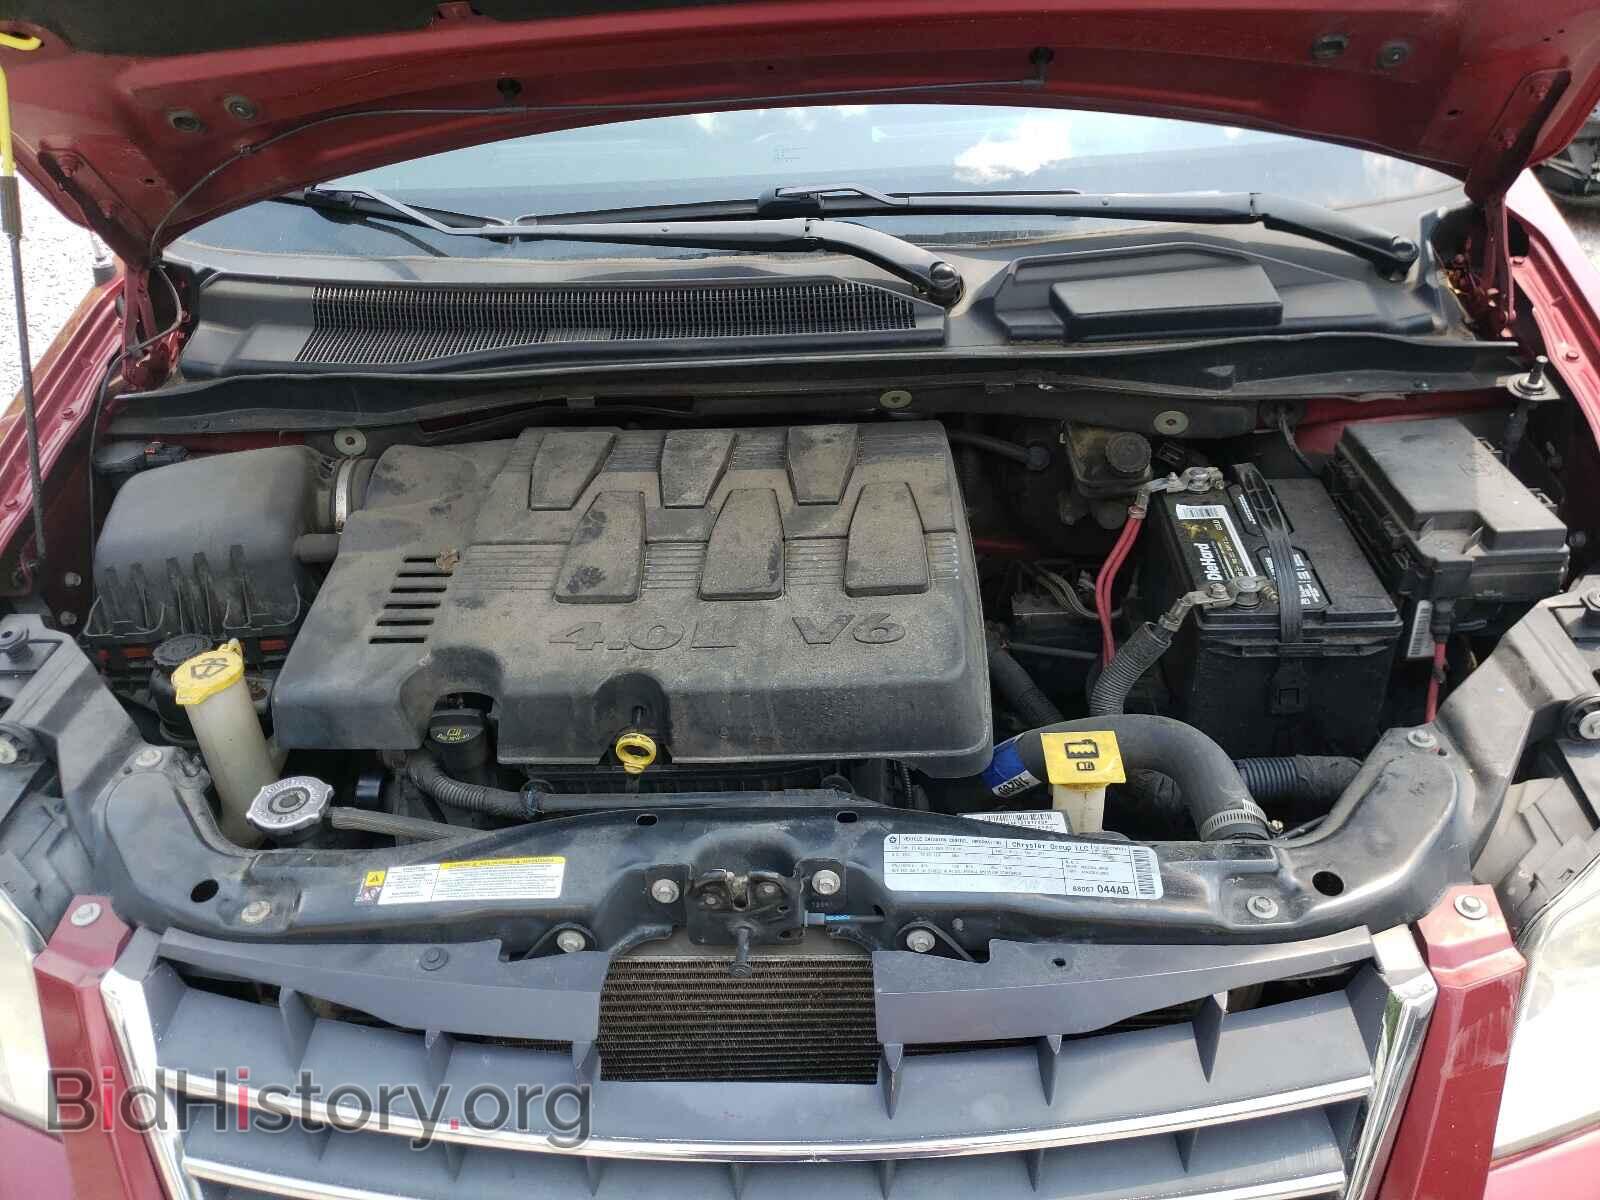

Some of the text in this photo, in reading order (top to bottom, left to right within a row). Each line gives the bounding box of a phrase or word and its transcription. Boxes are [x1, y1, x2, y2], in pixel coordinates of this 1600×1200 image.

[1194, 542, 1220, 582] DieHard
[549, 613, 906, 651] 4.0L V6
[1011, 841, 1046, 850] Chrysler
[1050, 843, 1071, 852] Group
[1097, 884, 1130, 895] 044AB
